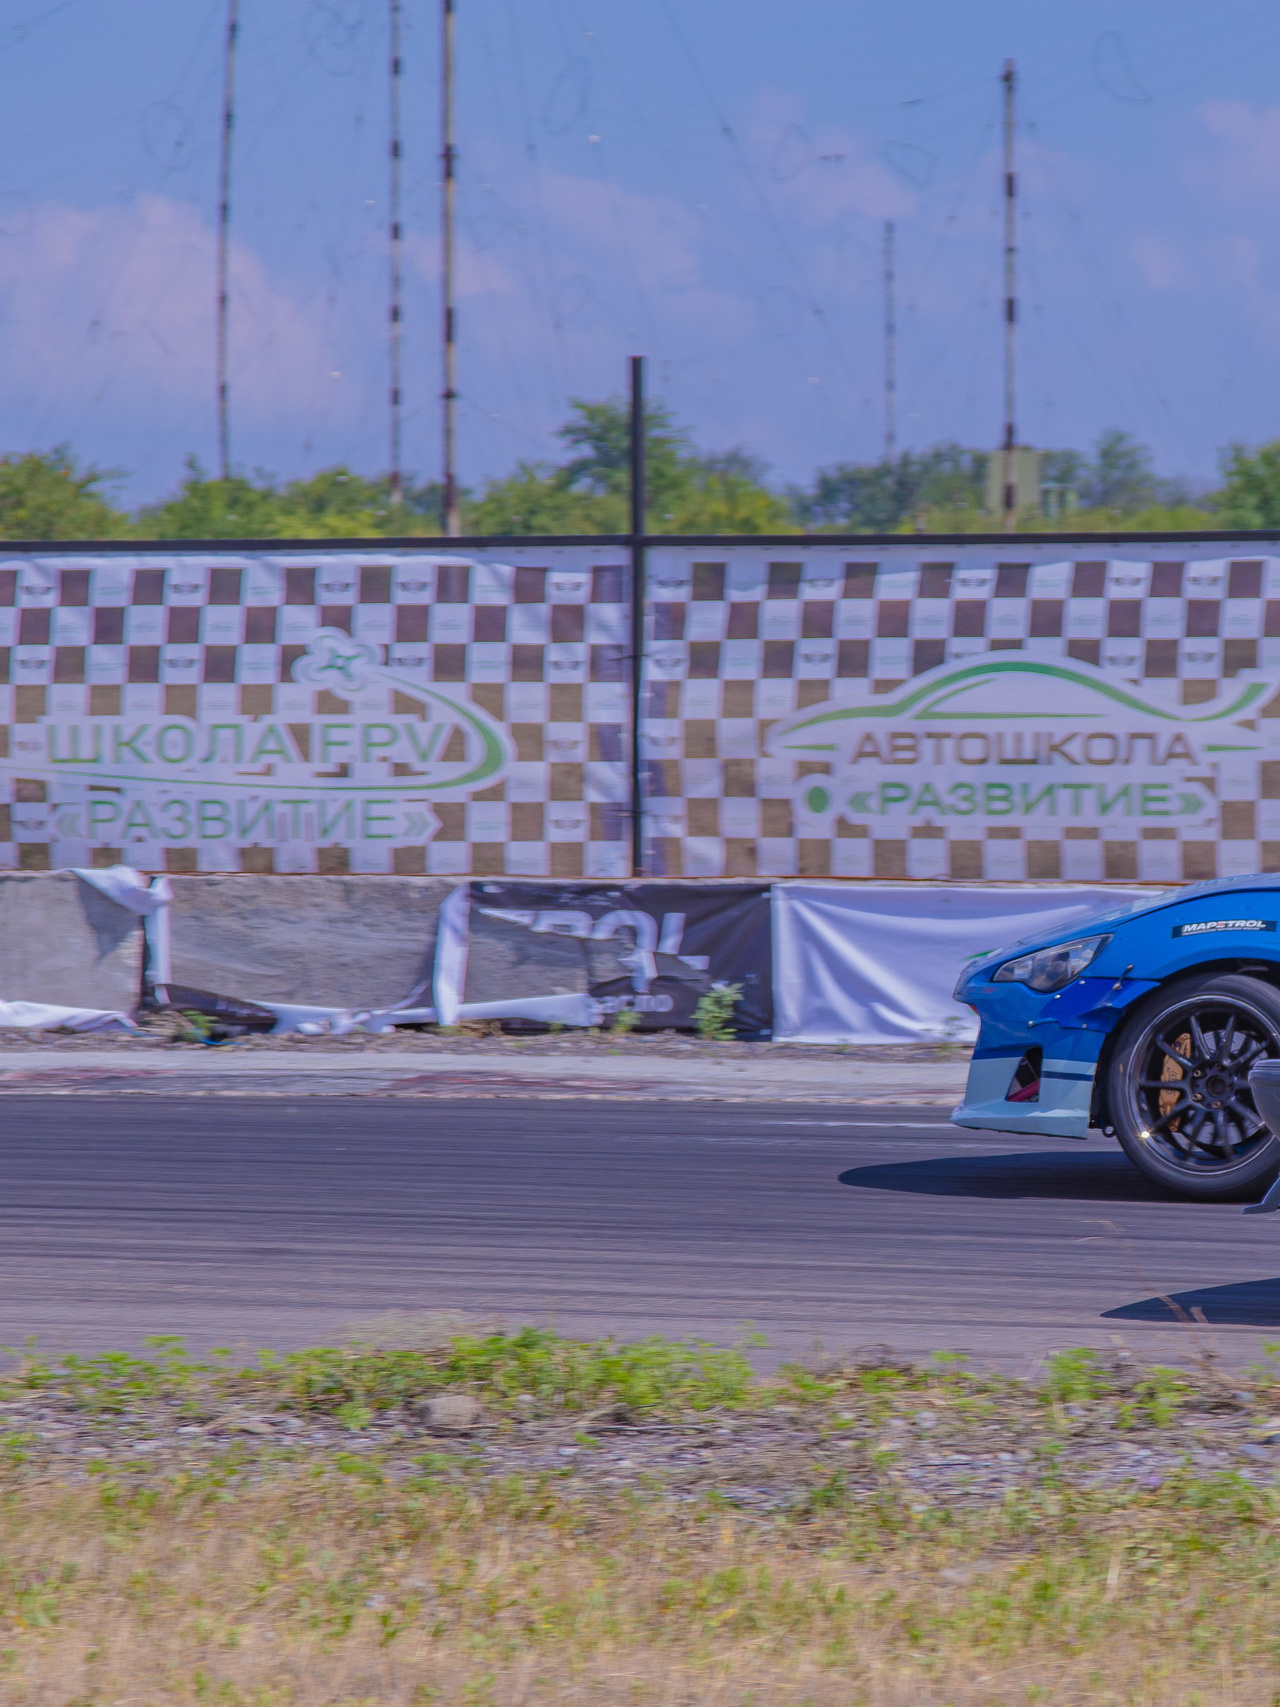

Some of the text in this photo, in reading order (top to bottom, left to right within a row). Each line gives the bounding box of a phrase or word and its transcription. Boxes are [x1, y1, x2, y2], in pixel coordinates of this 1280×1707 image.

[47, 723, 447, 764] ШКОЛА FPV
[850, 731, 1198, 765] АВТОШКОЛА
[1183, 920, 1266, 932] MAPETROL
